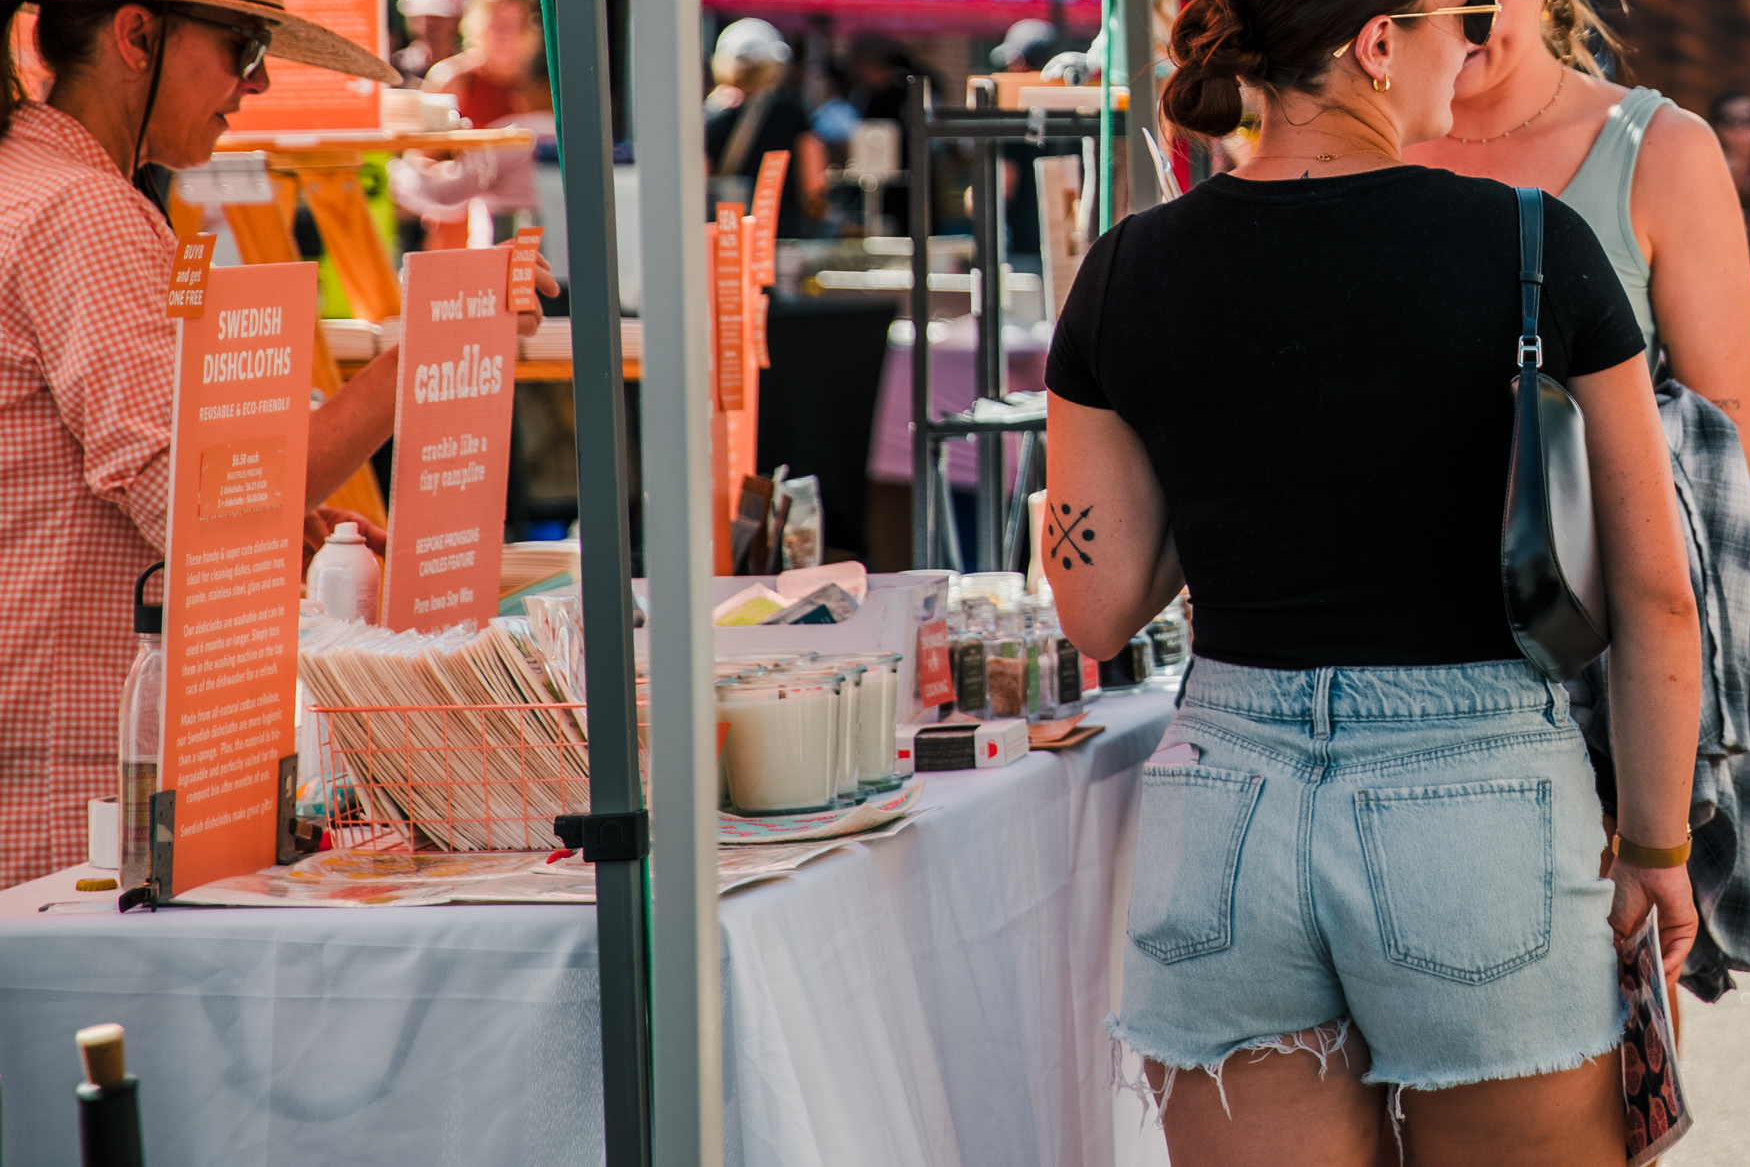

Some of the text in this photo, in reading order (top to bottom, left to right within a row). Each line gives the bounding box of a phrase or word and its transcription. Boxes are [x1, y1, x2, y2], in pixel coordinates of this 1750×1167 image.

[176, 267, 201, 285] and get
[169, 290, 203, 305] ONE FREE
[431, 288, 496, 322] wood wick
[218, 306, 282, 340] SWEDISH
[204, 346, 292, 384] DISHCLOTHS
[414, 344, 503, 404] candles
[199, 397, 290, 421] REUSABLE & ECO-FRIENDLY
[232, 451, 259, 467] $6.50 each
[421, 434, 487, 462] crackle like a
[220, 487, 223, 495] 2
[224, 482, 243, 494] dishcloths
[420, 461, 485, 496] tiny campfire
[218, 499, 220, 508] 3
[225, 495, 244, 507] dishcloths
[186, 554, 201, 566] These
[203, 548, 219, 563] handy
[226, 547, 241, 559] super
[242, 545, 253, 556] cute
[254, 538, 279, 553] dishcloths
[280, 538, 288, 548] are
[416, 527, 480, 555] BESPOKE PROVISIONS
[186, 572, 200, 586] ideal
[201, 569, 210, 583] for
[211, 567, 233, 580] cleaning
[253, 560, 272, 572] counter
[419, 551, 475, 577] CANDLES FEATURE
[186, 592, 207, 608] granite,
[208, 586, 231, 601] stainless
[248, 580, 261, 595] glass
[261, 578, 271, 589] and
[414, 587, 474, 614] Pure Iowa Soy Wax
[184, 605, 285, 637] Our dishcloths are washable and can be
[186, 643, 199, 656] used
[205, 637, 225, 651] months
[226, 636, 232, 646] or
[251, 628, 268, 641] Simply
[269, 626, 280, 637] toss
[182, 644, 283, 677] them in the washing machine or the top
[185, 683, 197, 695] rack
[199, 681, 205, 692] of
[206, 678, 215, 690] the
[216, 672, 245, 689] dishwasher
[246, 669, 254, 680] for
[181, 714, 196, 726] Made
[198, 710, 210, 722] from
[212, 700, 239, 718] all-natural
[240, 699, 256, 711] cotton
[177, 709, 282, 747] our Swedish dishcloths are more hygienic
[179, 754, 191, 766] than
[197, 747, 218, 764] sponge.
[235, 738, 243, 749] the
[244, 732, 265, 747] material
[177, 766, 208, 787] degradable
[209, 764, 219, 777] and
[220, 757, 244, 776] perfectly
[245, 753, 260, 766] suited
[269, 748, 278, 759] the
[187, 786, 210, 804] compost
[211, 783, 220, 795] bin
[221, 778, 233, 793] after
[234, 774, 253, 789] months
[254, 771, 260, 782] of
[180, 821, 203, 837] Swedish
[205, 813, 231, 830] dishcloths
[233, 807, 246, 821] make
[247, 804, 260, 818] great
